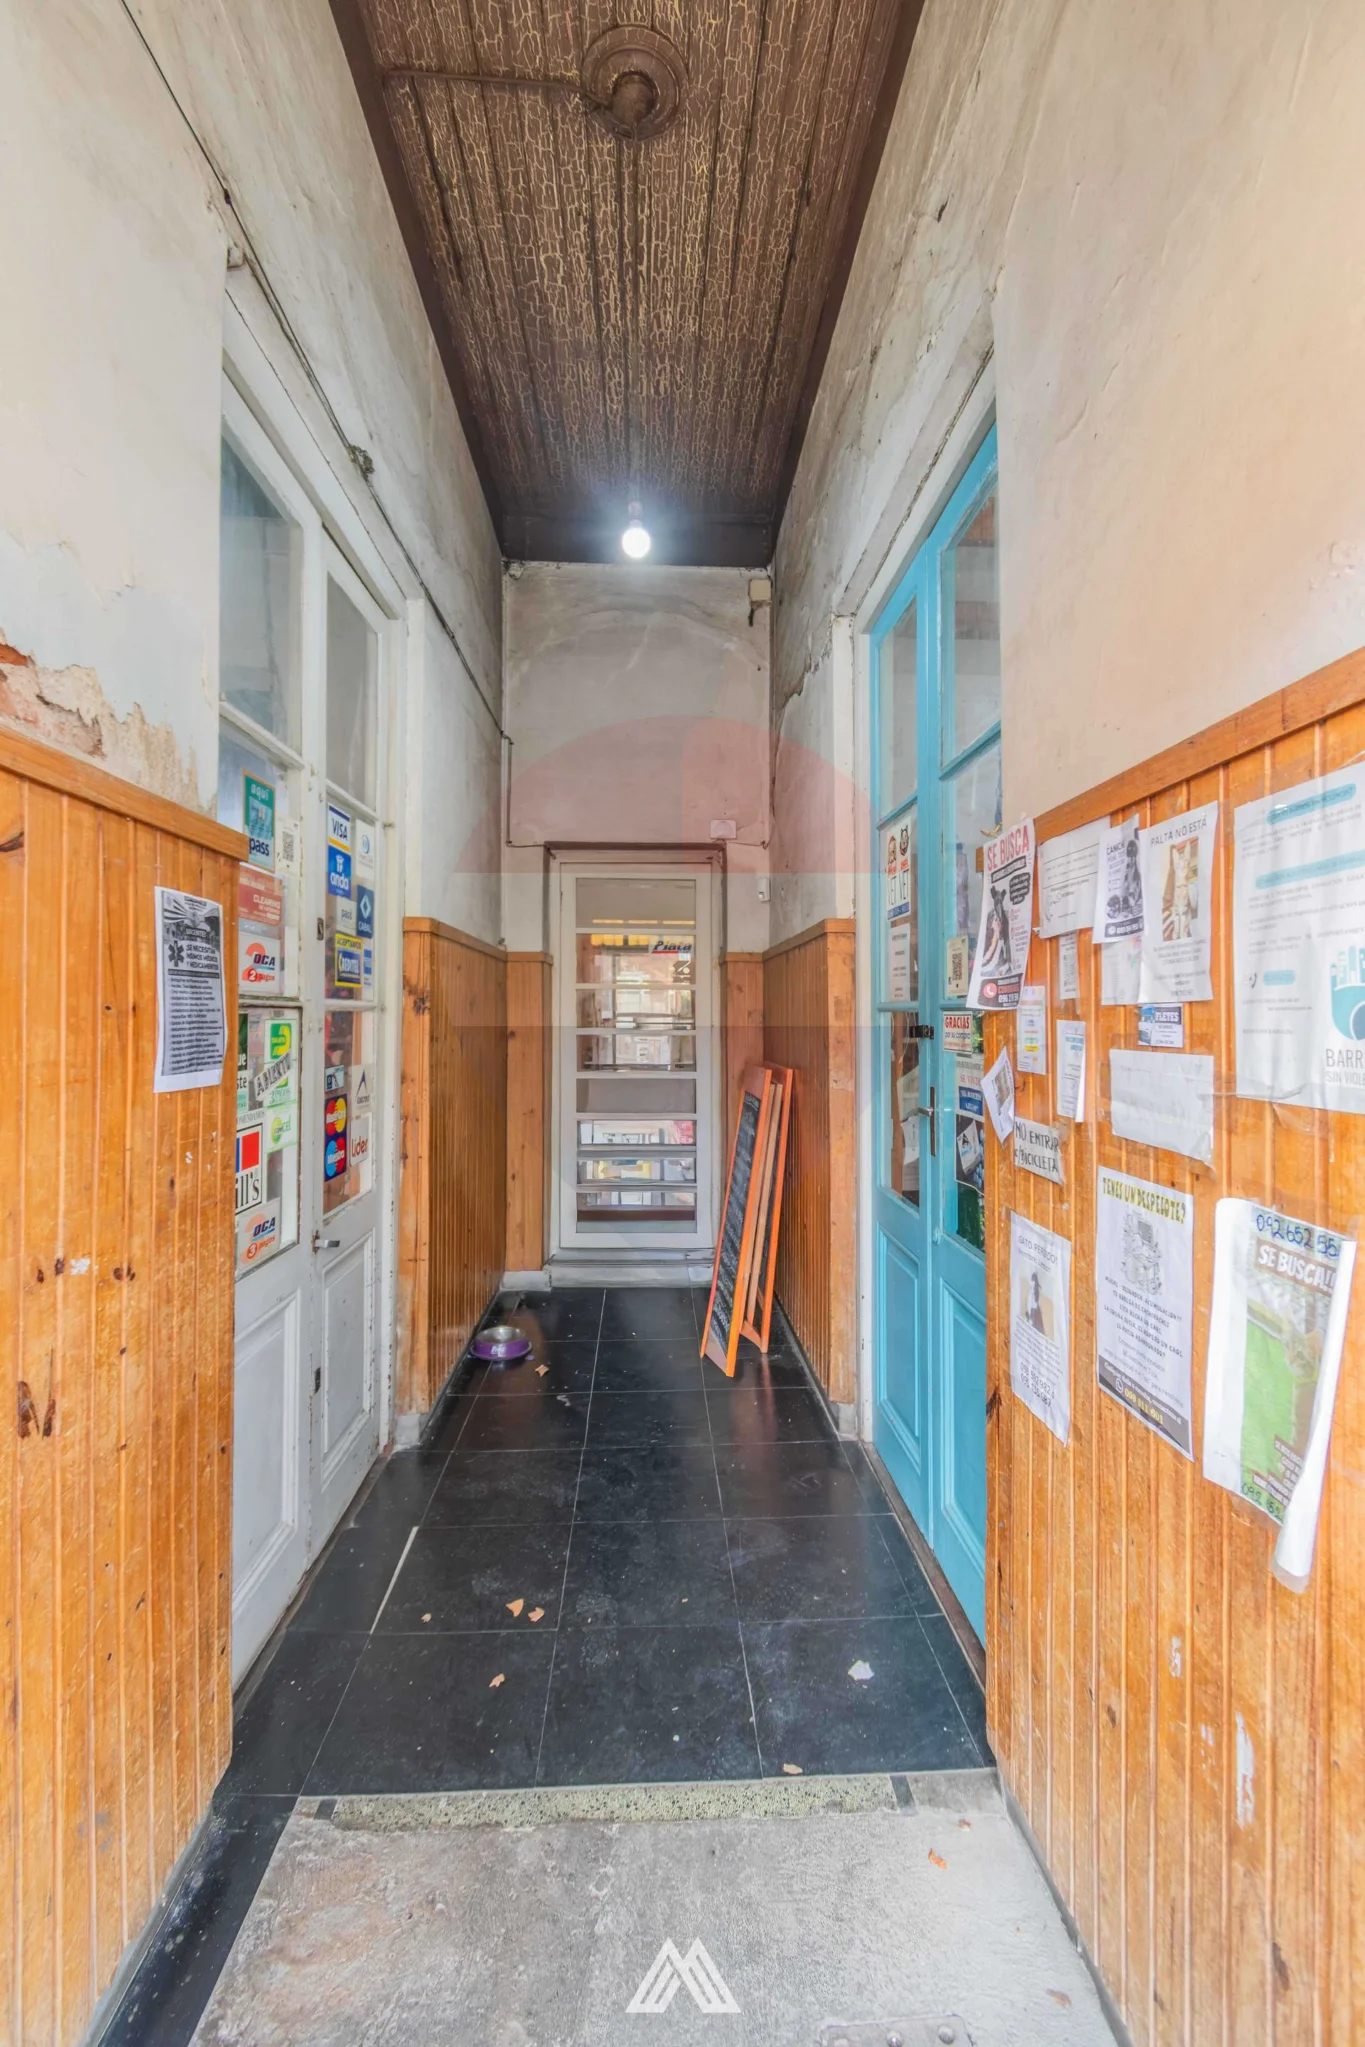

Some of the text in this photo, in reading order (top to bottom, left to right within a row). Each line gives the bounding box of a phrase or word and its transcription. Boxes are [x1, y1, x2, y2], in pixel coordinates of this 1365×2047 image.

[331, 818, 349, 841] VISA
[1150, 831, 1174, 848] PALTA
[1176, 825, 1188, 838] NO
[249, 837, 270, 857] pass
[986, 842, 998, 872] SE
[1000, 825, 1030, 865] BUSCA
[330, 872, 349, 891] anda
[253, 954, 276, 967] OCA
[248, 968, 257, 982] 2
[945, 1016, 971, 1029] GRACIAS
[1154, 1011, 1180, 1022] FLETES
[1325, 1070, 1342, 1084] SIN
[1015, 1121, 1059, 1152] NO ENTRAR
[1102, 1176, 1123, 1200] TENES
[1124, 1183, 1136, 1205] UN
[253, 1216, 277, 1238] OCA
[1256, 1213, 1285, 1240] 092
[1286, 1224, 1314, 1250] 652
[1258, 1244, 1277, 1268] SE
